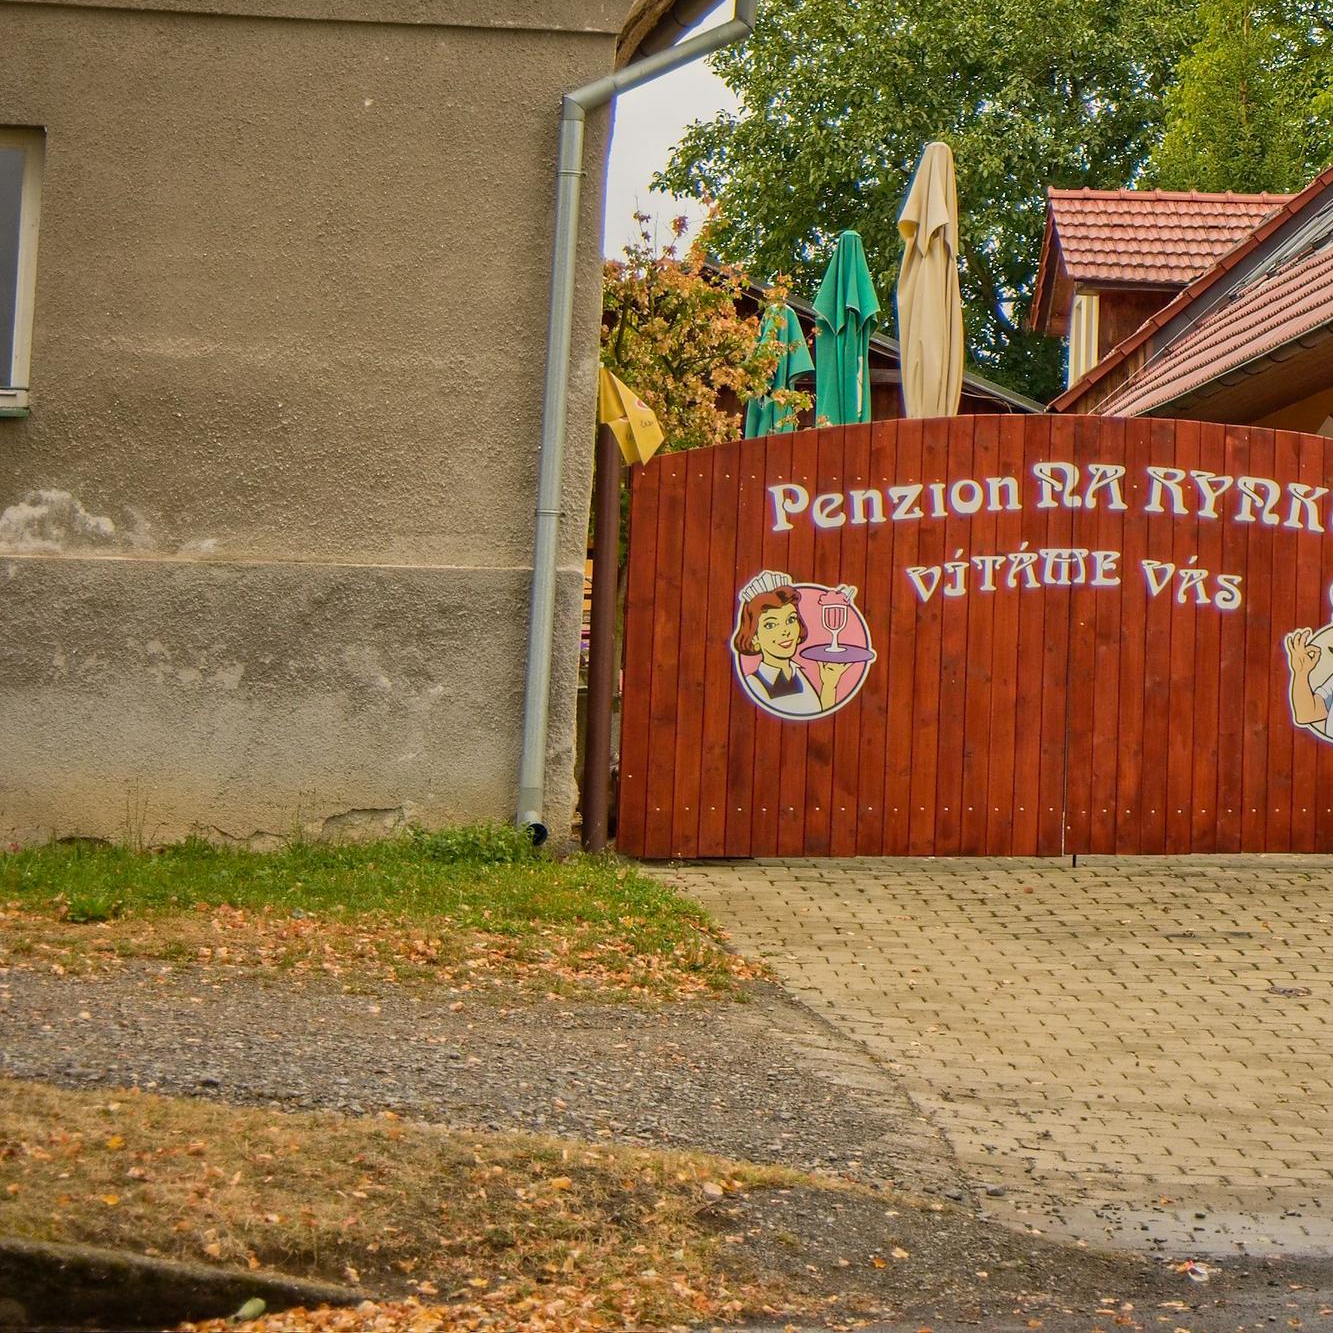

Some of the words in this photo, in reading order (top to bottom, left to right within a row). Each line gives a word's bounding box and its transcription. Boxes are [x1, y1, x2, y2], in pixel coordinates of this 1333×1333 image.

[768, 474, 1022, 532] Penzion
[1032, 461, 1127, 509] NA
[906, 541, 1121, 603] VÍTÁME
[1141, 555, 1243, 610] VÁS
